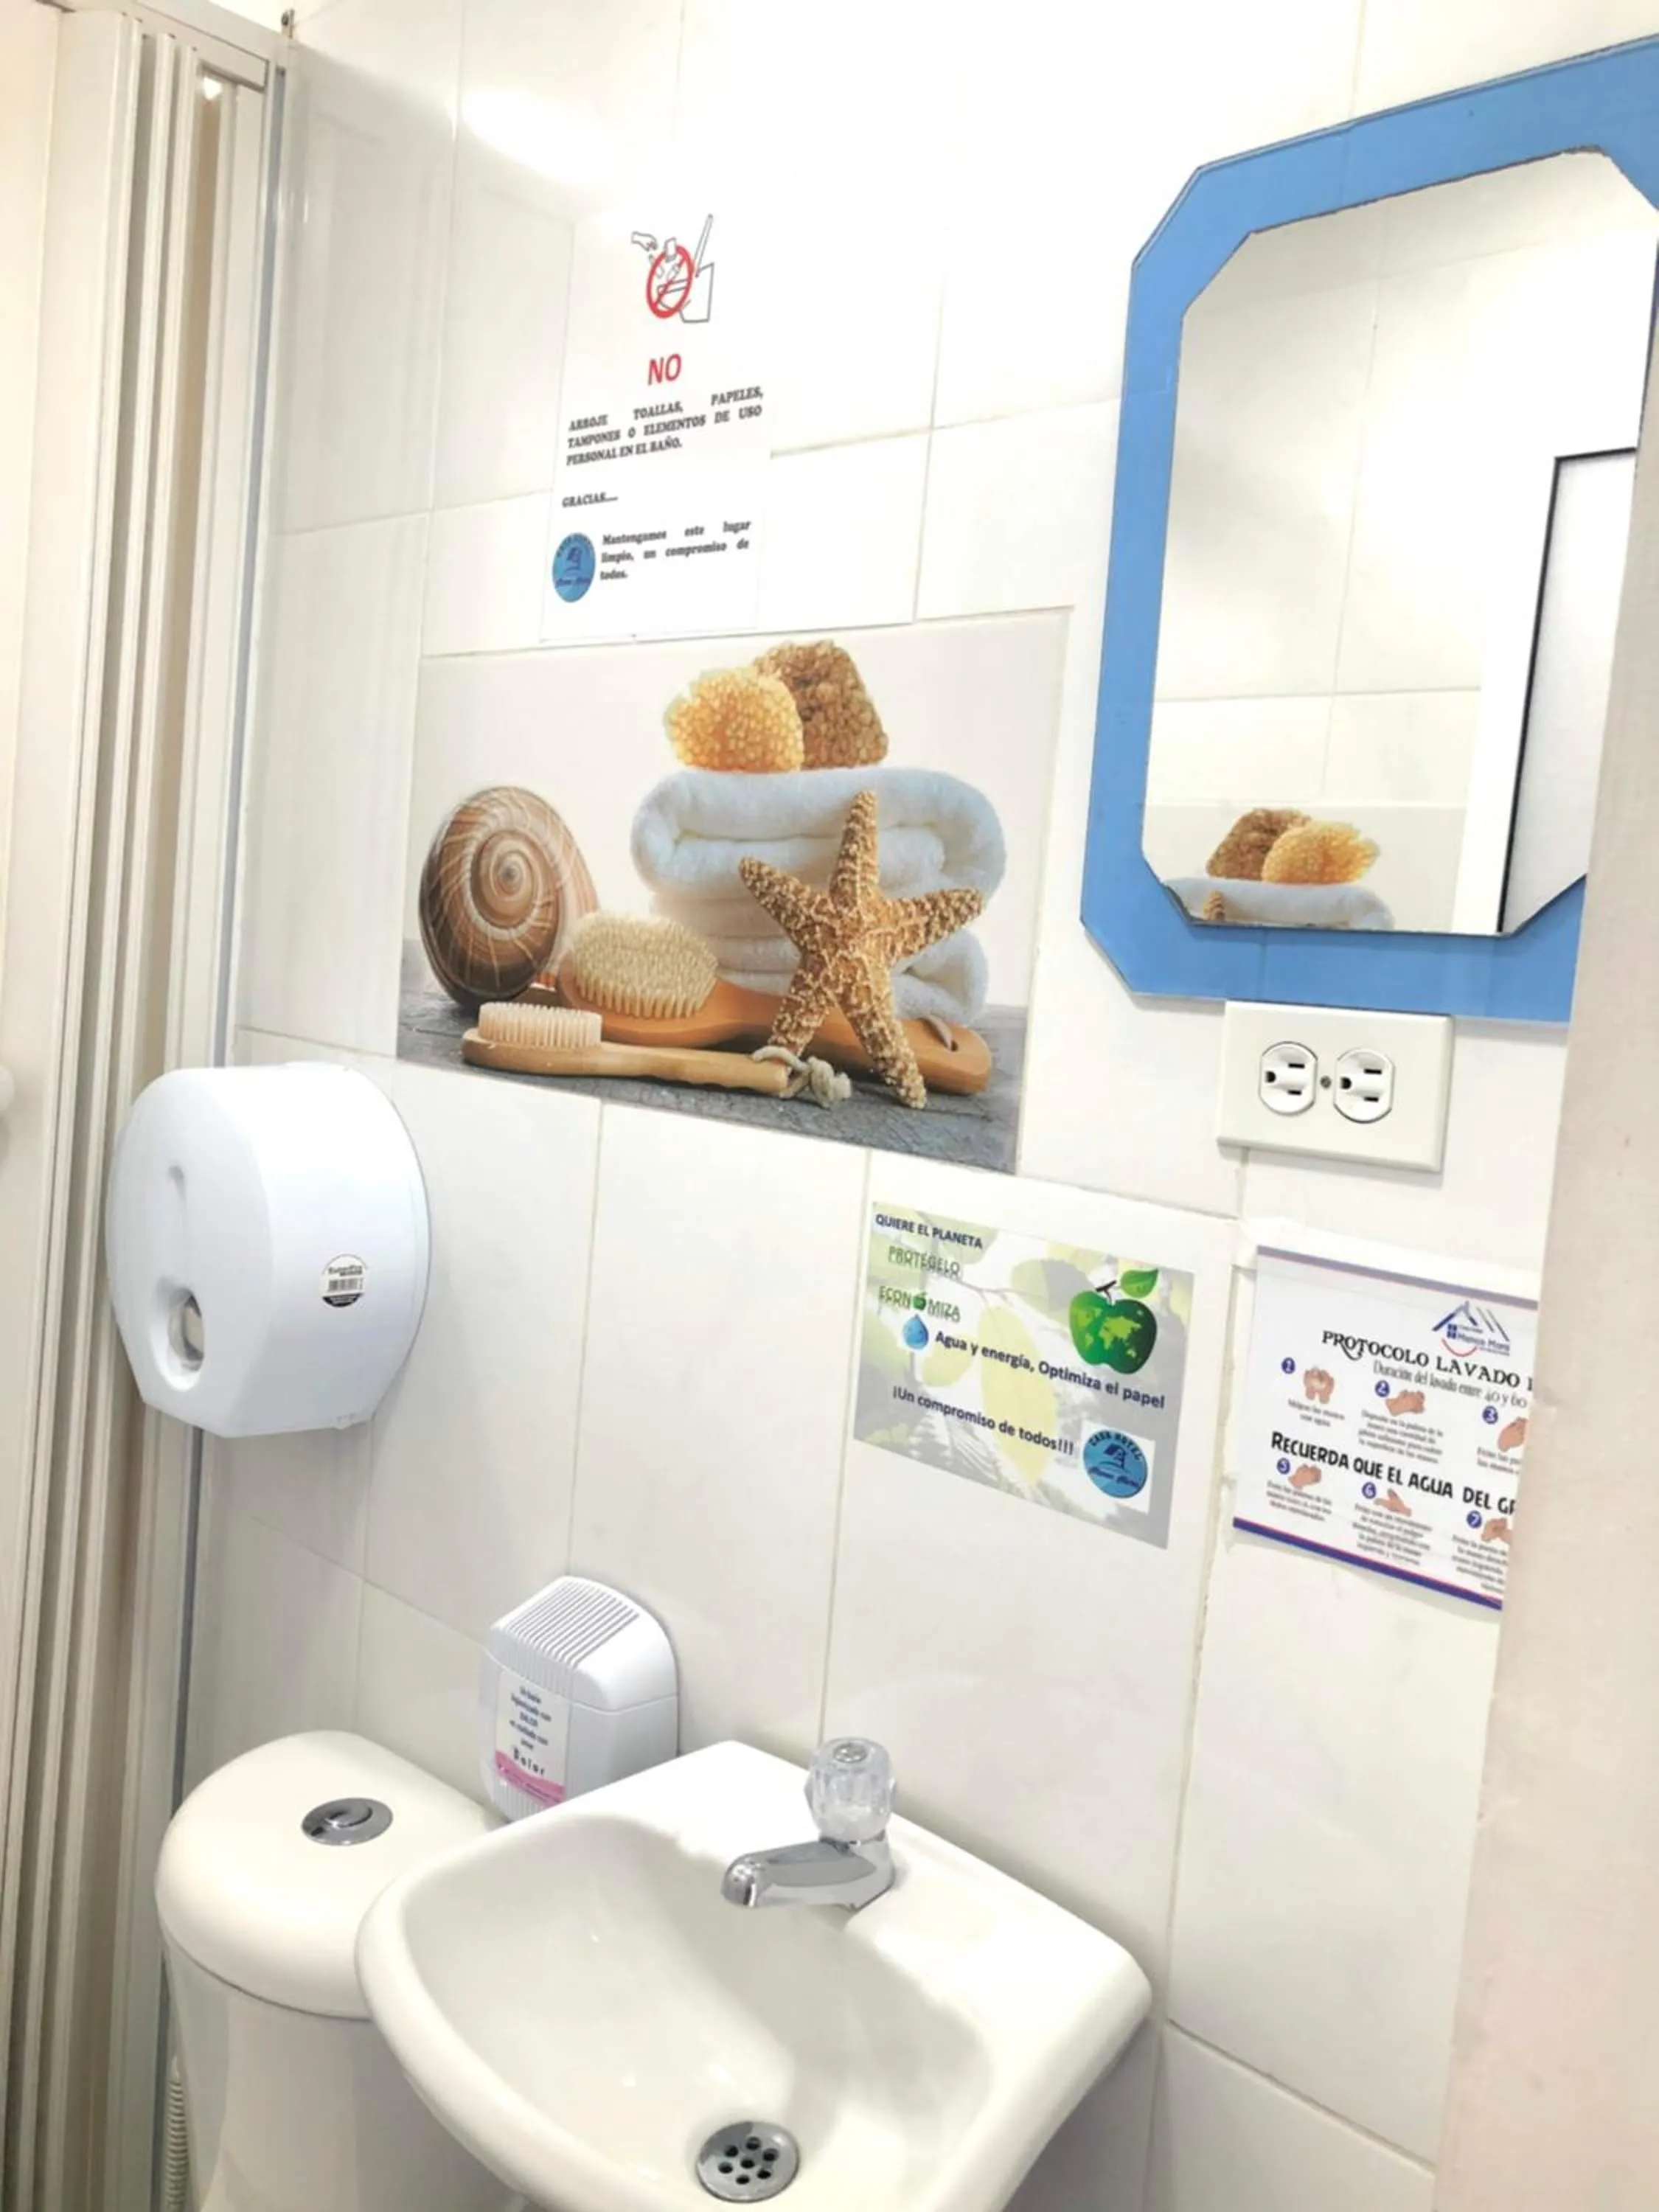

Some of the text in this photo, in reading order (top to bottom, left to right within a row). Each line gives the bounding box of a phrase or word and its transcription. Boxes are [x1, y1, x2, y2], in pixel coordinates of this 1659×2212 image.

[648, 353, 682, 386] NO
[568, 386, 764, 431] ARROJE TOALLAS, PAPELES,
[568, 405, 762, 448] TAMPONES O ELEMENTOS DE USO
[566, 435, 682, 466] PERSONAL EN EL BAÑO.
[601, 538, 749, 564] limpio, un compromiso de
[602, 531, 667, 546] Mantengamos
[684, 526, 704, 537] este
[723, 521, 751, 535] lugar
[599, 568, 628, 581] todos.
[875, 1213, 983, 1249] QUIERE EL PLANETA
[935, 1331, 1166, 1410] Agua y energía, Optimiza el papel
[1321, 1330, 1430, 1367] PROTOCOLO
[1436, 1356, 1521, 1388] LAVADO
[917, 1395, 996, 1430] compromiso
[998, 1421, 1016, 1437] de
[1019, 1427, 1074, 1456] todos!!!
[1270, 1431, 1349, 1470] RECUERDA
[1353, 1457, 1383, 1480] QUE
[1387, 1467, 1403, 1486] EL
[1407, 1472, 1453, 1499] AGUA
[1462, 1487, 1492, 1509] DEL
